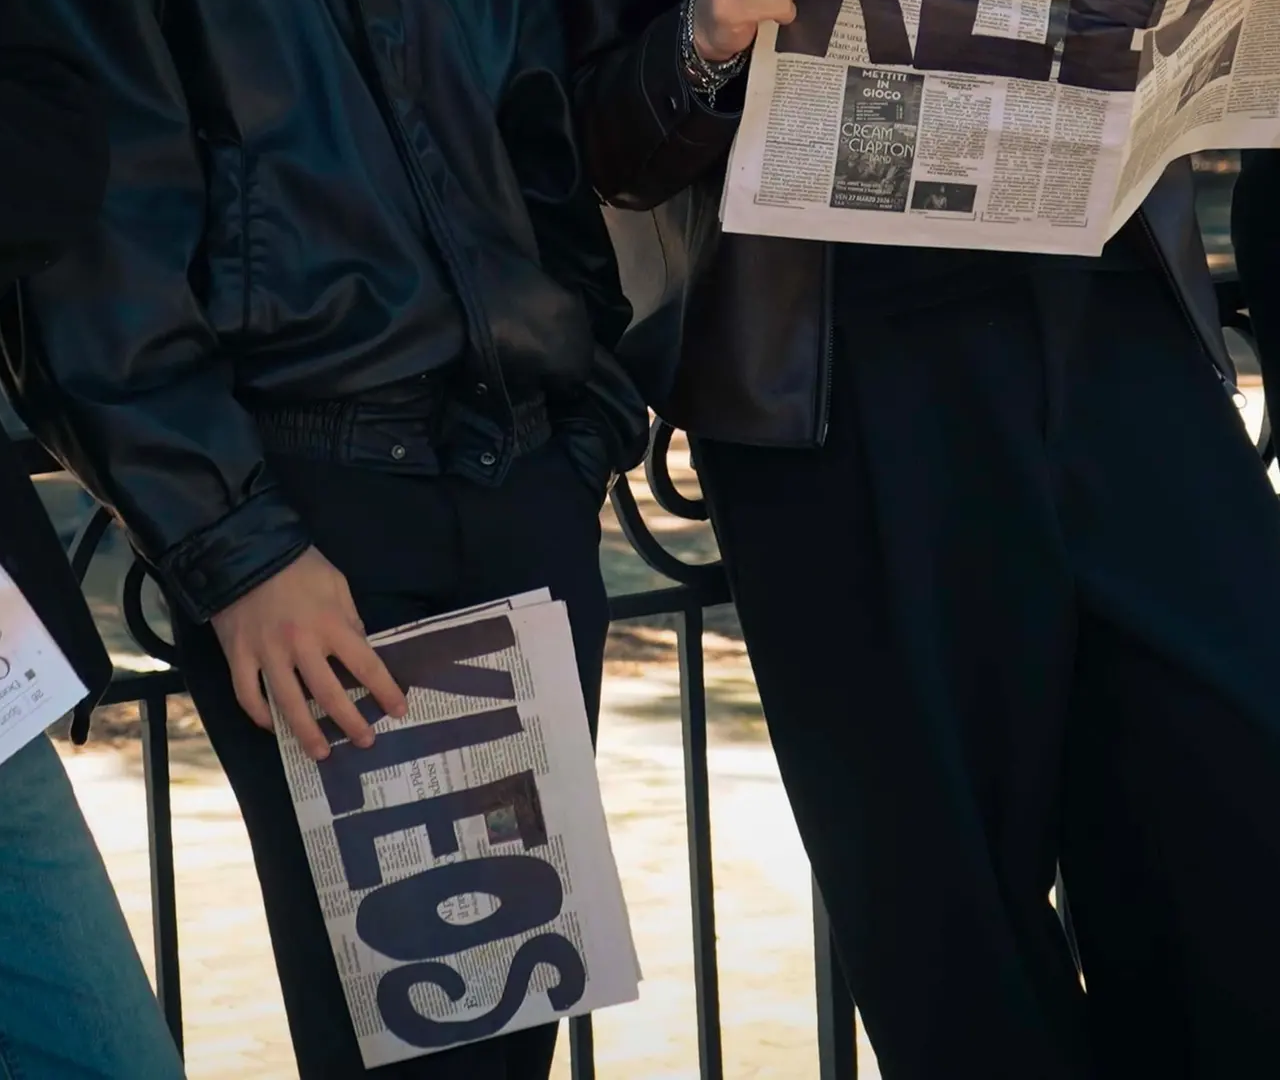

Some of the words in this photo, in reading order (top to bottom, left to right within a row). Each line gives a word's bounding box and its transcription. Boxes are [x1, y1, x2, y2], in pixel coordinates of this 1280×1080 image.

[862, 70, 908, 81] METTITI
[877, 79, 890, 88] IN
[863, 89, 901, 100] GIOCO
[842, 122, 894, 141] CREAM
[849, 138, 915, 158] CLAPTON
[300, 614, 587, 1048] KLEOS
